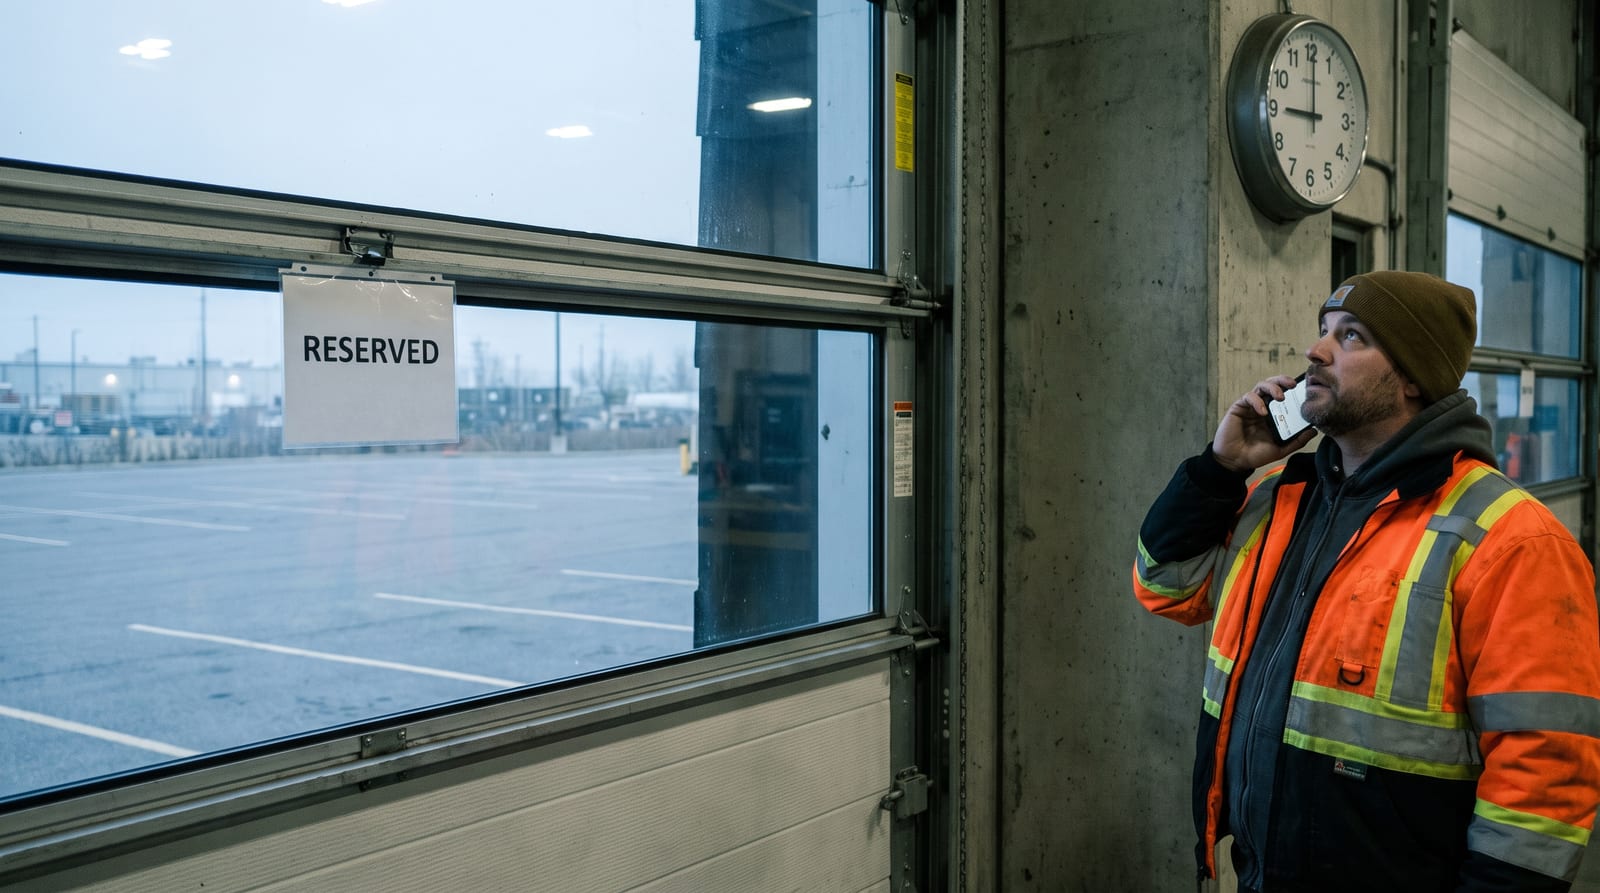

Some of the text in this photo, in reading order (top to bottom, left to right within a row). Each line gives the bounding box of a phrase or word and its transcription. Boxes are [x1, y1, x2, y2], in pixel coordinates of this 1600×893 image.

[1287, 48, 1298, 67] 11
[1305, 43, 1318, 63] 12
[1326, 56, 1331, 74] 1
[1274, 69, 1288, 89] 10
[1337, 82, 1345, 100] 2
[1269, 99, 1278, 117] 9
[1341, 113, 1350, 131] 3
[1275, 132, 1284, 151] 8
[1336, 143, 1344, 160] 4
[1288, 157, 1297, 176] 7
[1323, 162, 1332, 180] 5
[1306, 169, 1314, 187] 6
[304, 335, 439, 364] RESERVED
